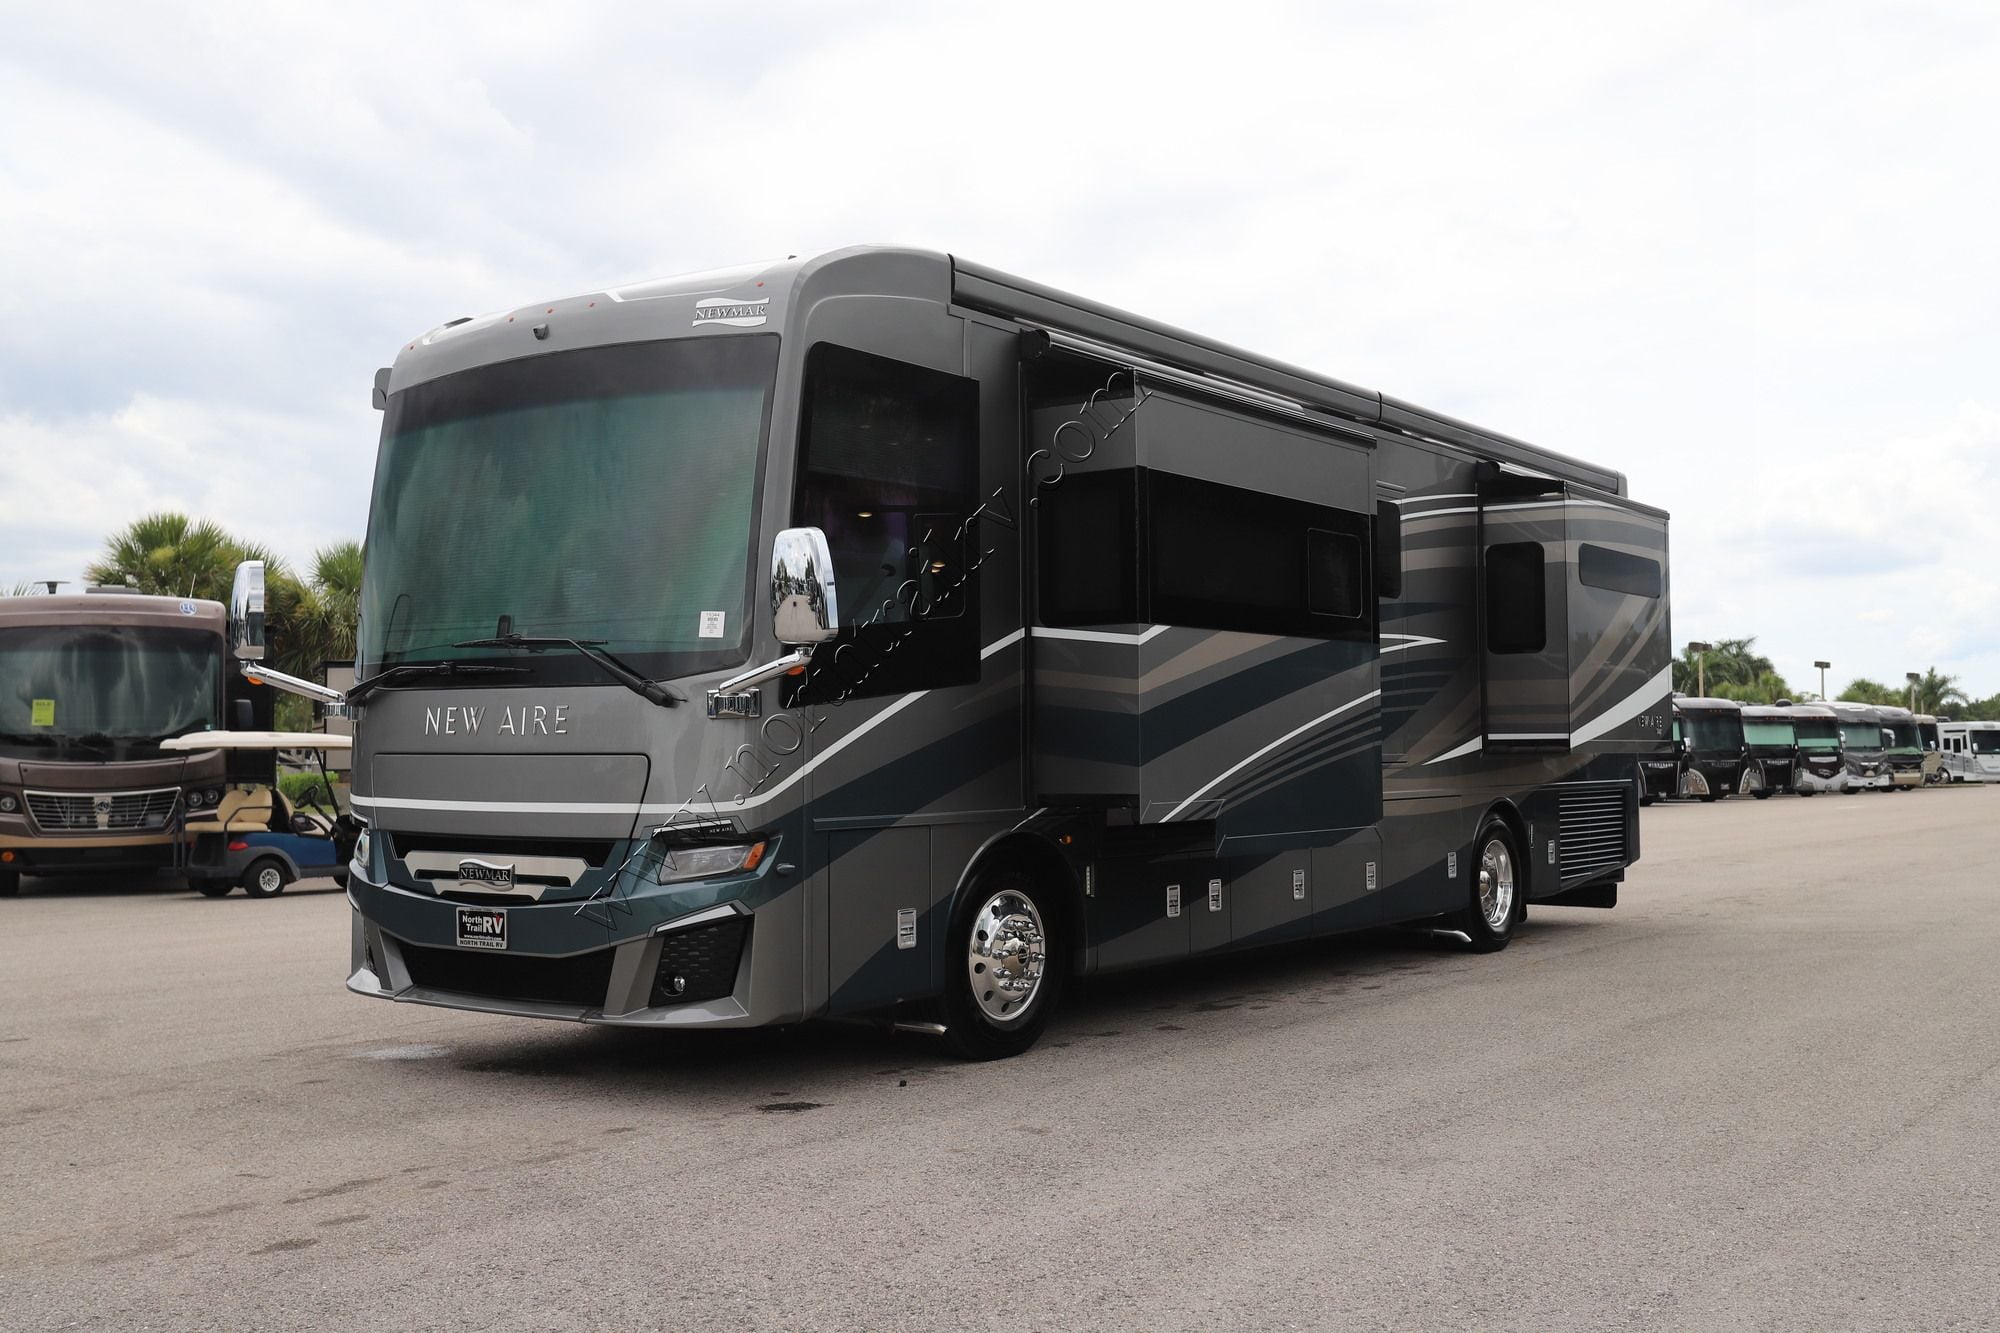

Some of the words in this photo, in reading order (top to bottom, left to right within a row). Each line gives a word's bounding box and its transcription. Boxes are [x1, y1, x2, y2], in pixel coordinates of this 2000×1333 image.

[695, 304, 766, 319] NEWMAR
[425, 706, 486, 736] NEW
[498, 705, 569, 735] AIRE
[459, 867, 510, 881] NEWMAR
[462, 914, 483, 924] North
[483, 916, 504, 935] RV
[466, 923, 483, 933] Trail
